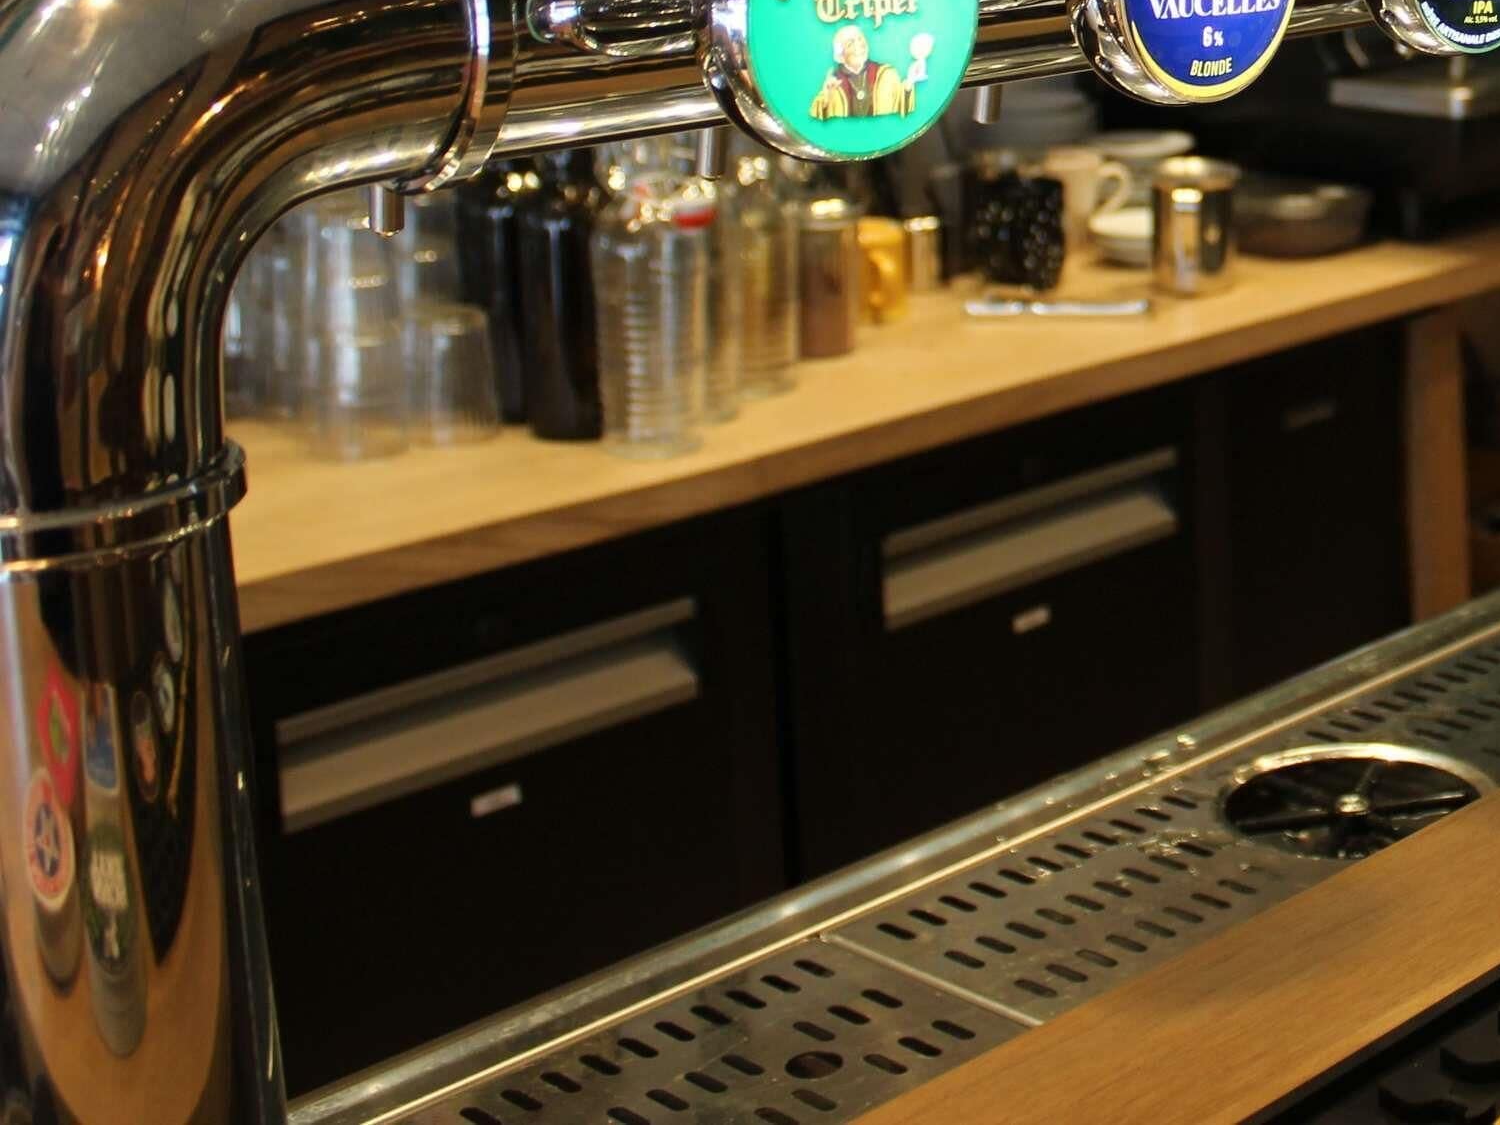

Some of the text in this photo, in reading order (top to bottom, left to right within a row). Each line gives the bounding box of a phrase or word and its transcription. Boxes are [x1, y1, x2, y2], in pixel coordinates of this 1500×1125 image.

[1473, 0, 1493, 14] IPA
[1202, 26, 1224, 47] 6%
[1190, 57, 1233, 77] BLONDE
